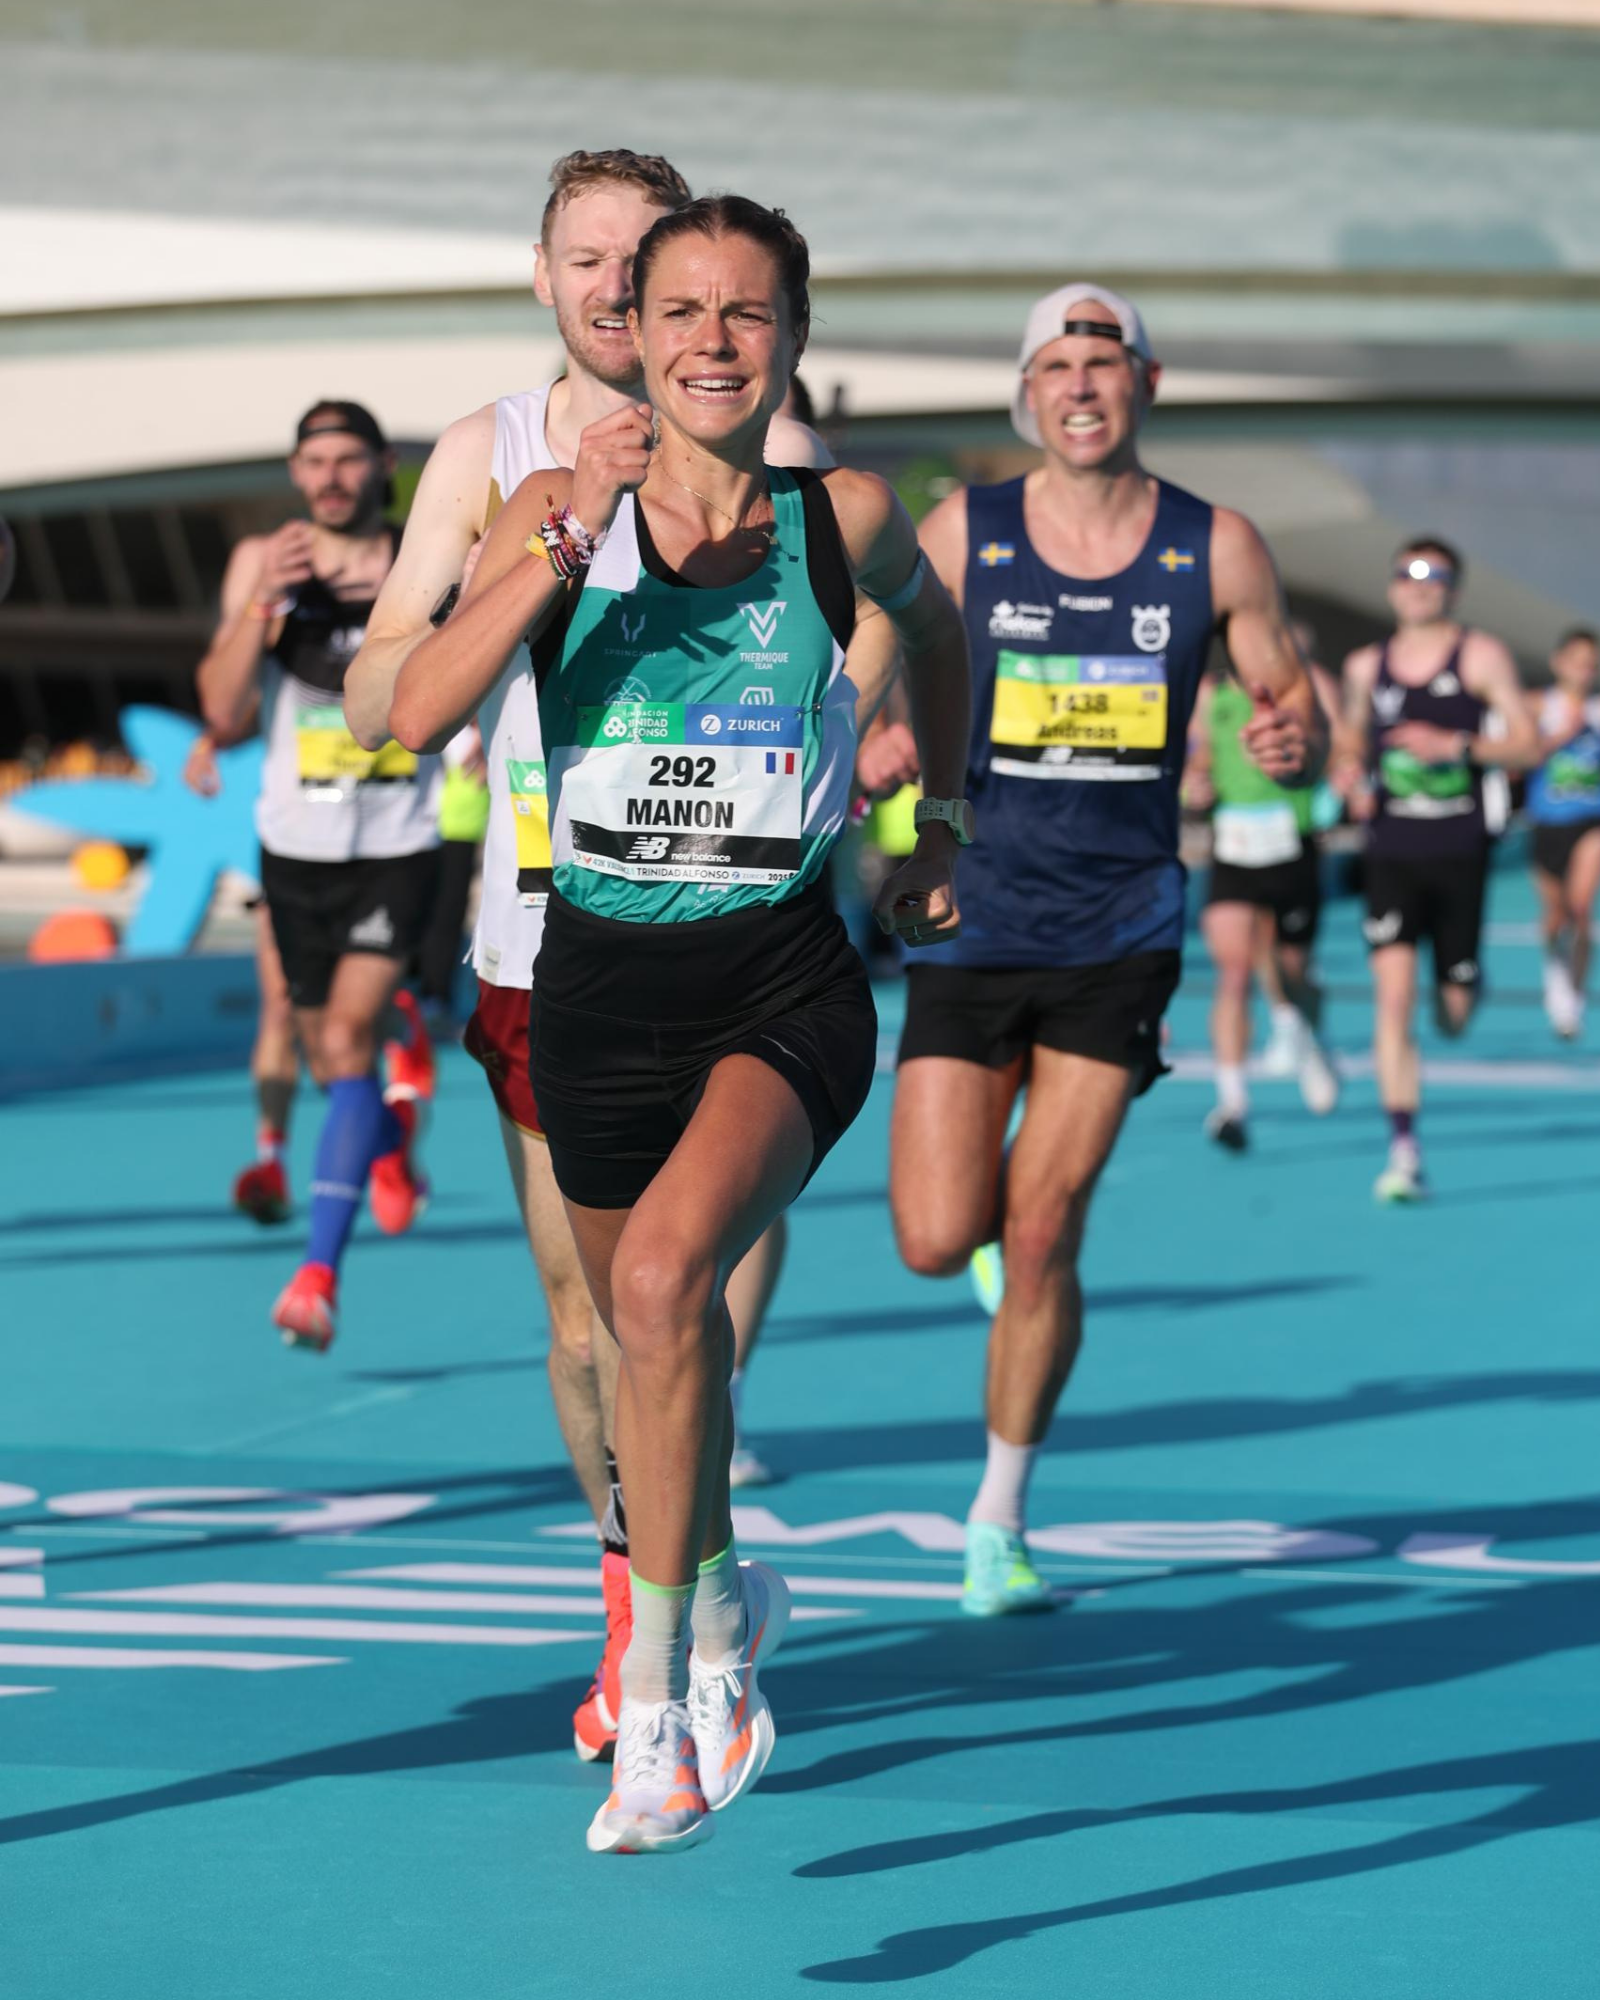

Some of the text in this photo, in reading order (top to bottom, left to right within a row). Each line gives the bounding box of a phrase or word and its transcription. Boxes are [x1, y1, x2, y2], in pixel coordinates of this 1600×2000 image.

[740, 652, 789, 664] THERMIQUE
[1048, 694, 1109, 714] 1438
[727, 719, 781, 732] ZURICH
[648, 755, 717, 788] 292
[626, 798, 734, 829] MANON
[671, 852, 732, 863] new balance
[637, 867, 681, 877] TRINIDAD
[682, 869, 730, 880] ALFONSO
